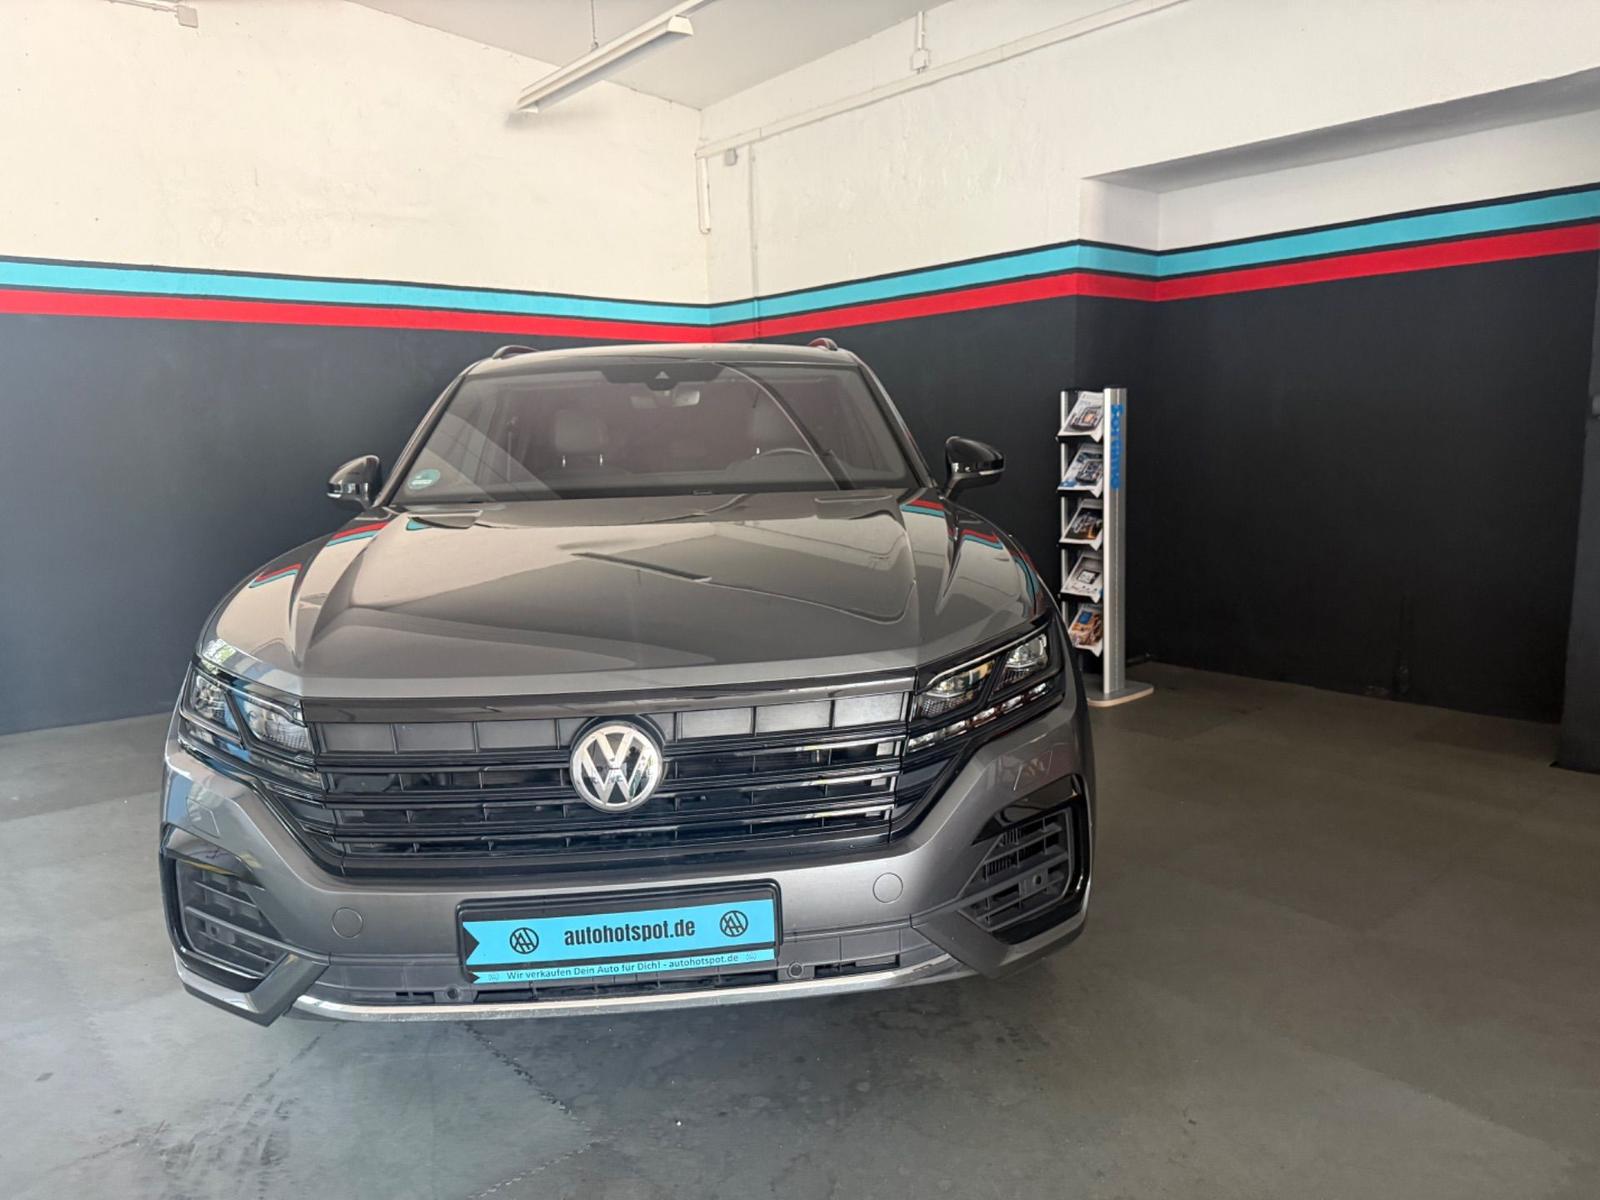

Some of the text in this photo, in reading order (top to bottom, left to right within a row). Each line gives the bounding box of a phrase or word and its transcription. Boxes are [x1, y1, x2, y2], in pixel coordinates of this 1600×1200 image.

[564, 919, 696, 946] autohotspot.de
[506, 971, 523, 980] Wir
[525, 967, 571, 978] verkaufen
[574, 966, 595, 976] Dein
[597, 965, 620, 974] Auto
[621, 963, 635, 972] für
[669, 954, 739, 969] autohotspot.de
